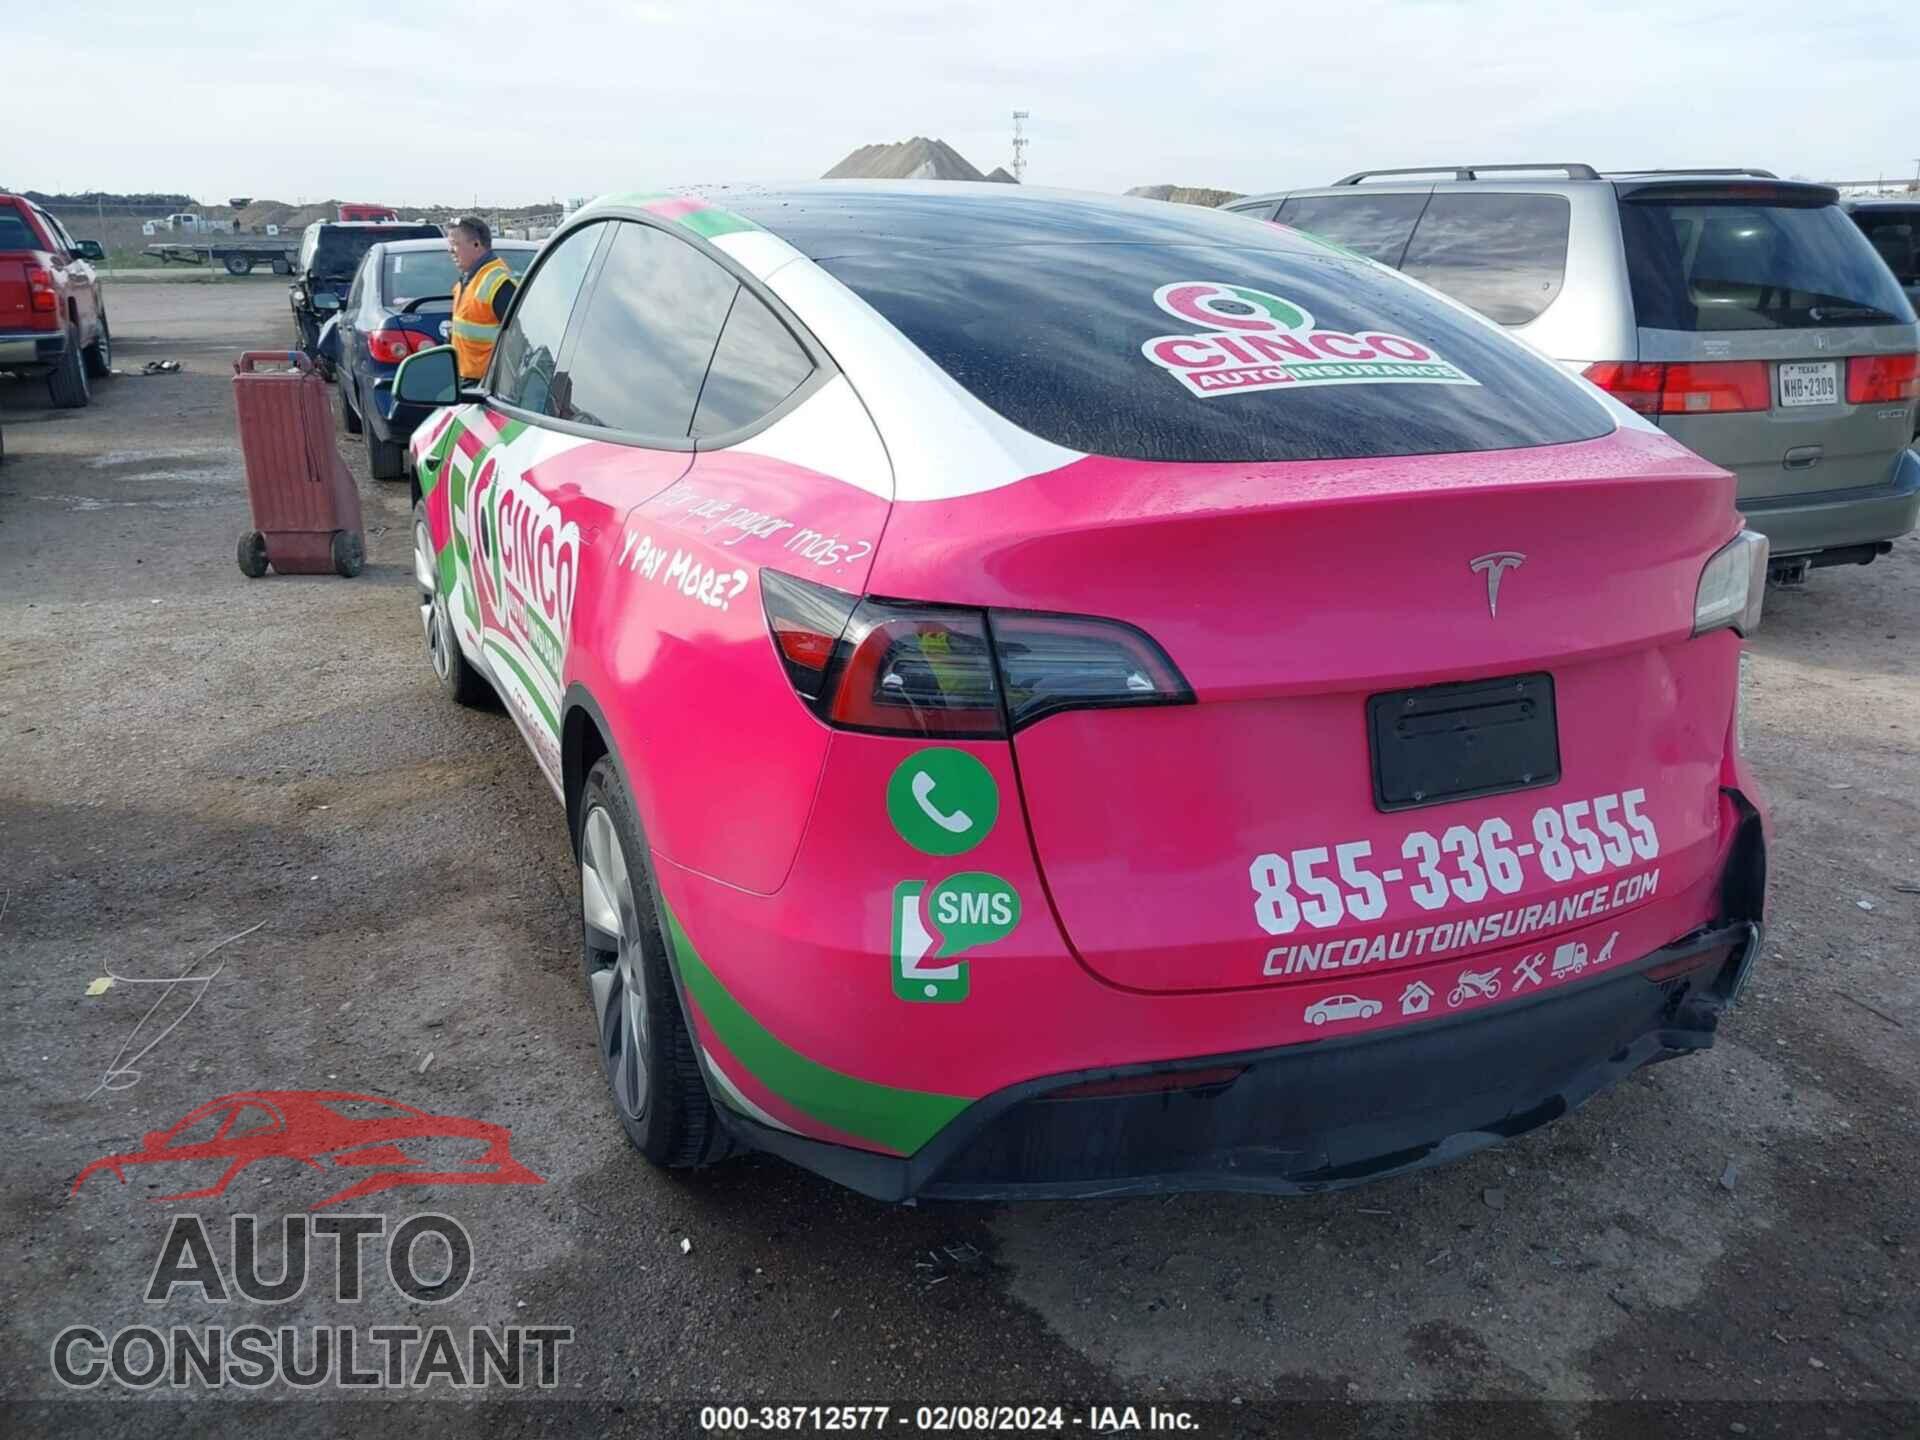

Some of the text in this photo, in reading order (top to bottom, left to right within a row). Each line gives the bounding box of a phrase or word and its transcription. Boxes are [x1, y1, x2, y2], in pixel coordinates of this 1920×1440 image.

[1153, 334, 1432, 368] CINCO
[1200, 364, 1459, 388] AUTO INSURANCE
[499, 488, 573, 638] CINCO
[618, 529, 749, 612] Y PAY MORE?
[1249, 788, 1660, 935] 855-336-8555
[937, 891, 1013, 925] SMS
[1262, 868, 1661, 978] CINCOAUTOINSURANCE.COM
